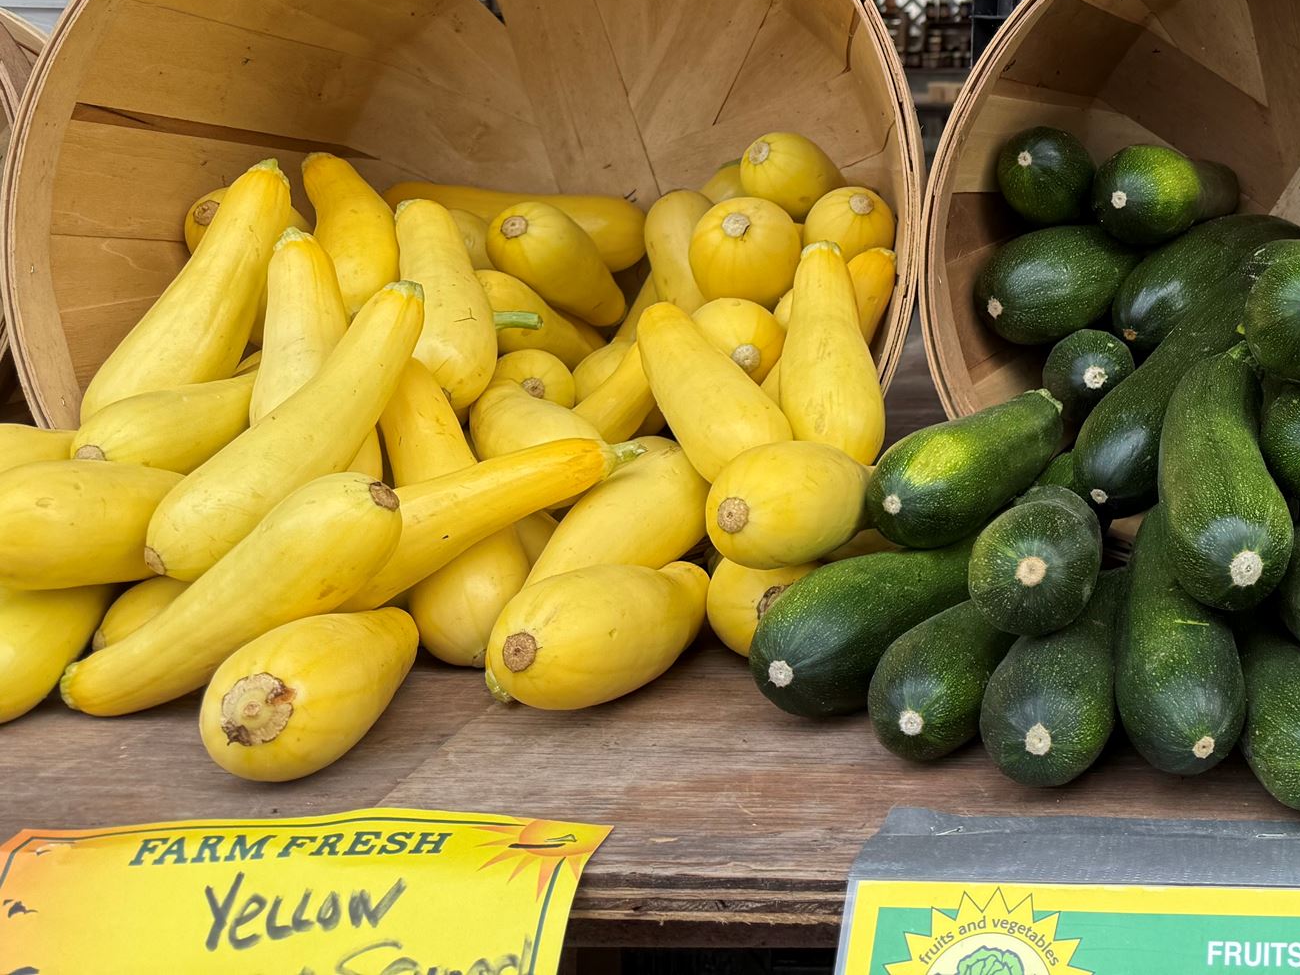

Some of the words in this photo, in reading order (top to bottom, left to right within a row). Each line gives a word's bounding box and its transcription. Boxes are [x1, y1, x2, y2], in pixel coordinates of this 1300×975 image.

[128, 835, 277, 866] FARM
[276, 831, 453, 857] FRESH
[919, 930, 955, 966] fruits
[958, 916, 986, 936] and
[992, 917, 1060, 967] vegetables
